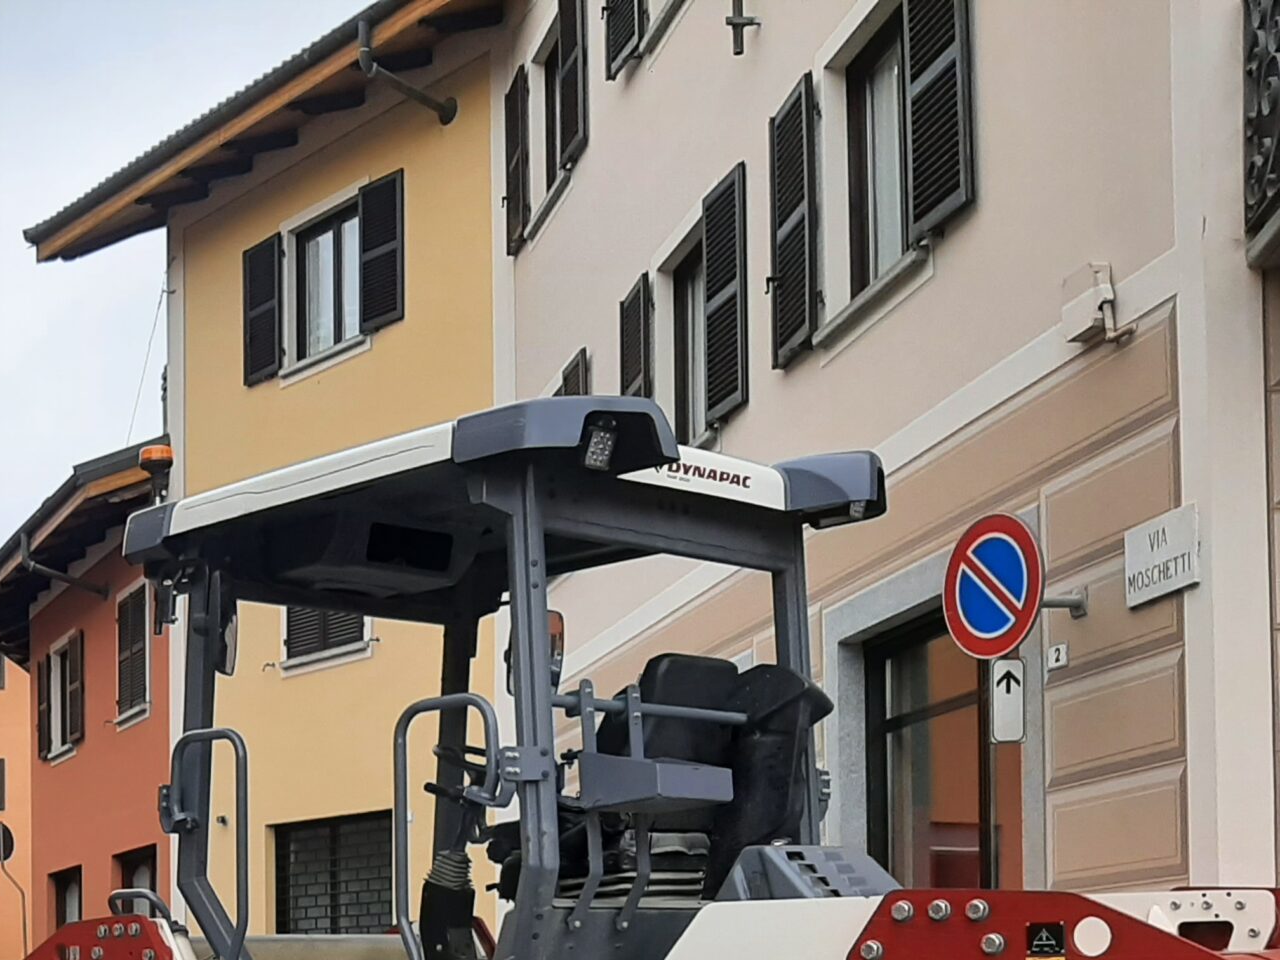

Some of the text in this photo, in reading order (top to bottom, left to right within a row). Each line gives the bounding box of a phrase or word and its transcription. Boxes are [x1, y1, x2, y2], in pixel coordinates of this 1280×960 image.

[667, 462, 751, 488] DYNAPAC
[1148, 526, 1168, 552] VIA
[1128, 551, 1191, 595] MOSCHETTI
[1054, 648, 1061, 663] 2
